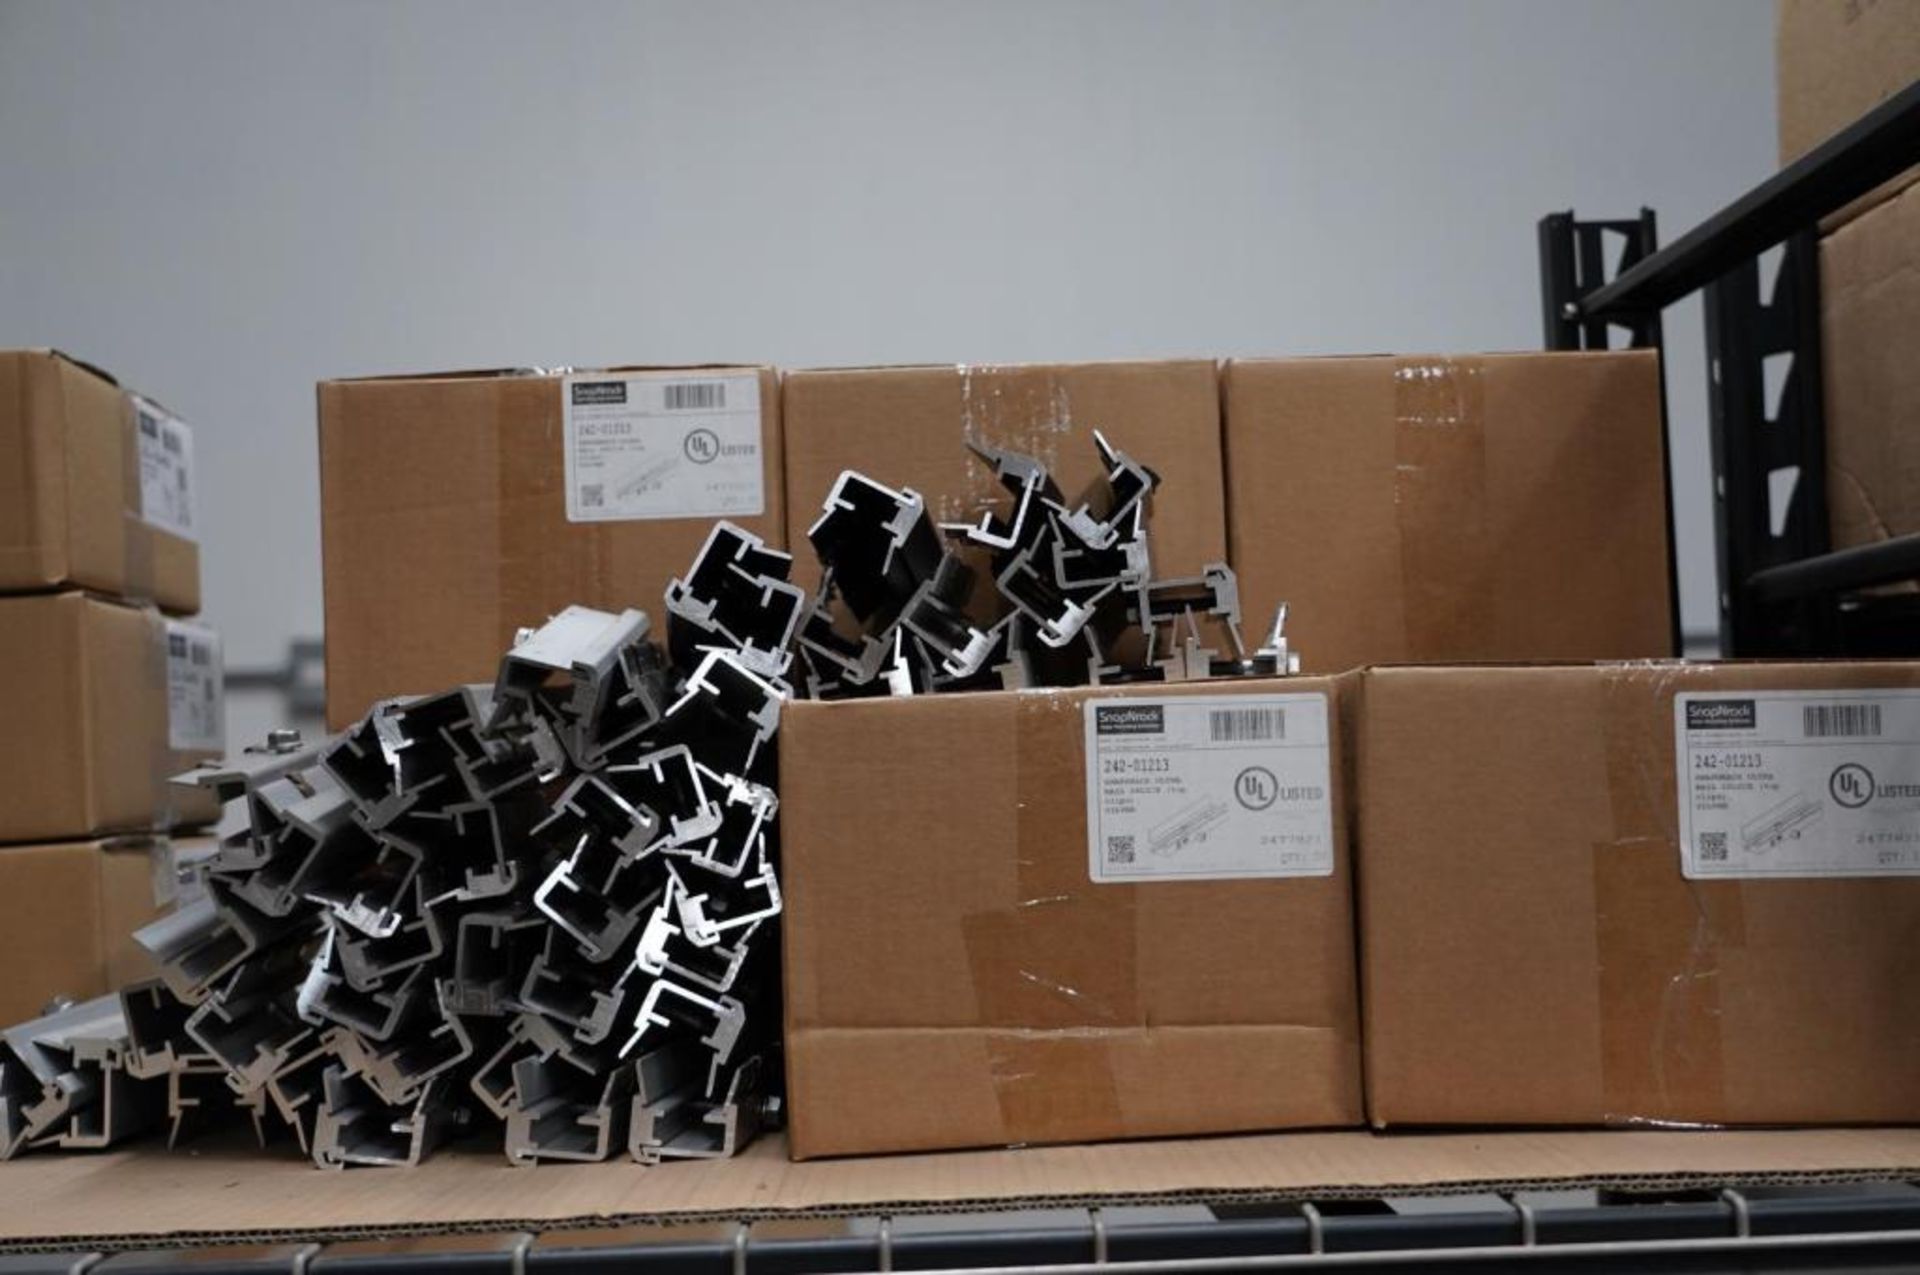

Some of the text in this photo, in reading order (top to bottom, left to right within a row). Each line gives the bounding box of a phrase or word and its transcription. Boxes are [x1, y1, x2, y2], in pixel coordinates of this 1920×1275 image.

[1104, 758, 1169, 773] 242-01213
[1694, 753, 1762, 768] 242-01213
[1245, 776, 1268, 801] UL
[1840, 773, 1864, 798] UL
[1280, 786, 1323, 801] LISTED
